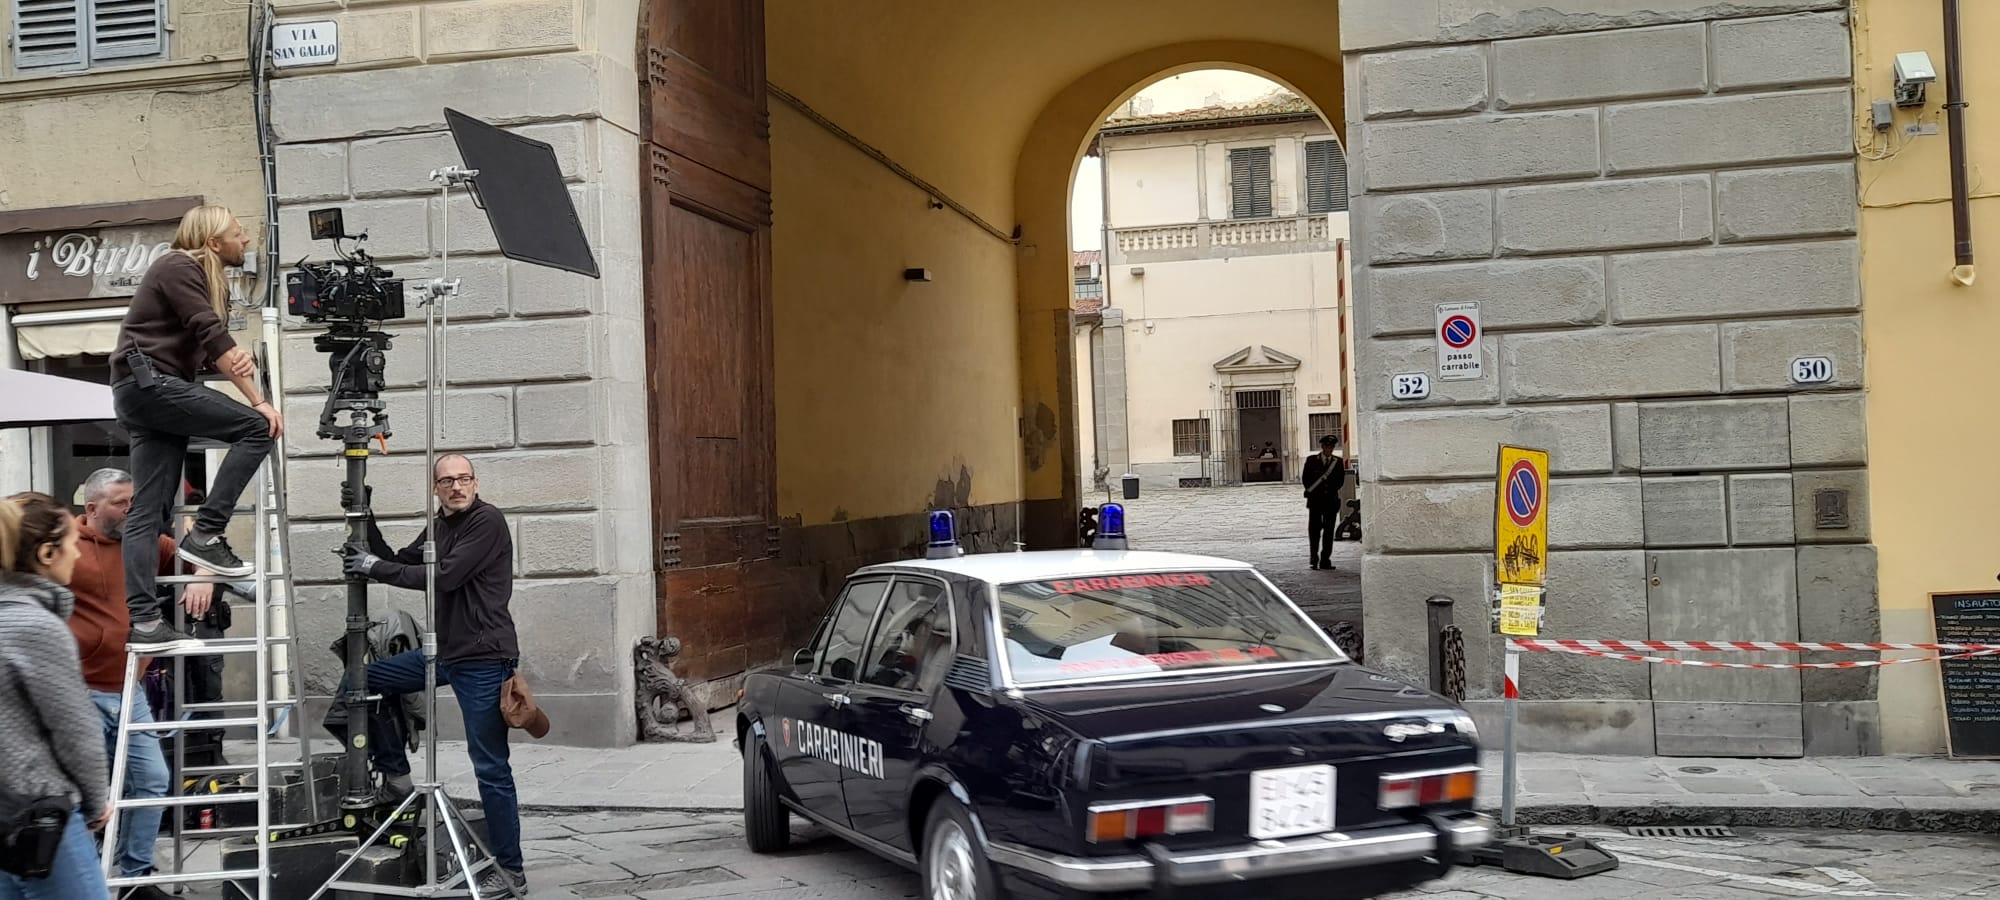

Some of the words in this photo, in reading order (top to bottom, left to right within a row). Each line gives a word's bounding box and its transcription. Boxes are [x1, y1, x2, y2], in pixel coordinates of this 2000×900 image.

[291, 28, 317, 40] VIA
[274, 47, 295, 60] SAN
[299, 43, 335, 57] GALLO
[1441, 361, 1480, 371] carrabile
[1447, 353, 1473, 361] passo
[1799, 360, 1826, 380] 50
[1399, 376, 1423, 395] 52
[1052, 573, 1211, 595] CARABINIERI
[797, 719, 885, 780] CARABINIERI
